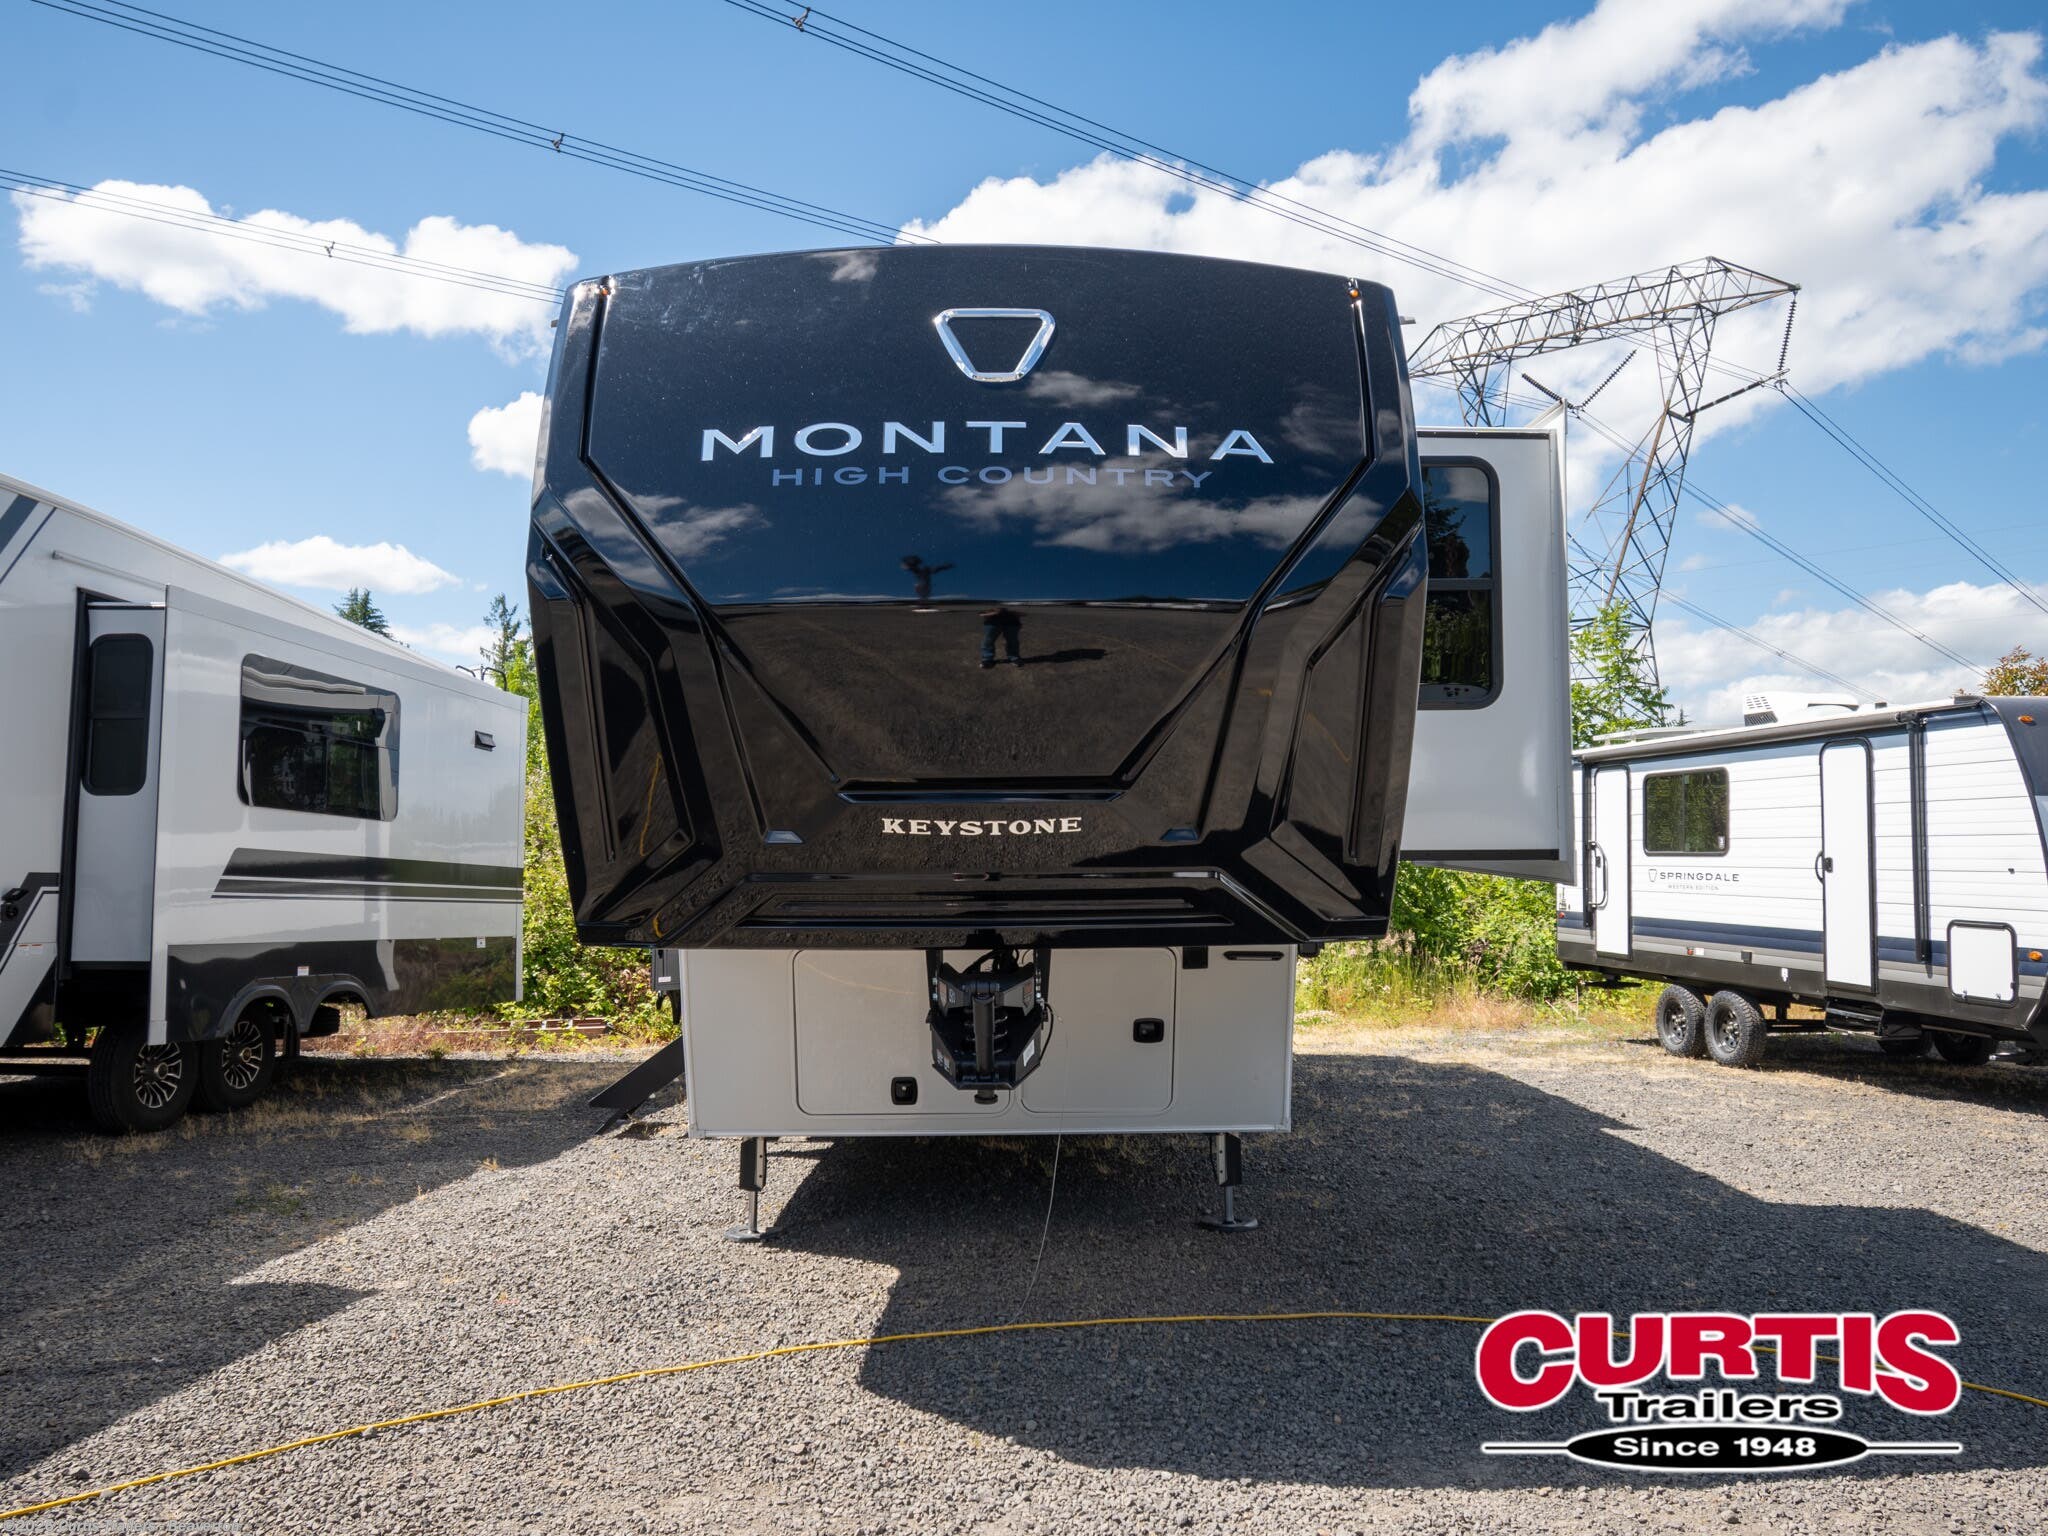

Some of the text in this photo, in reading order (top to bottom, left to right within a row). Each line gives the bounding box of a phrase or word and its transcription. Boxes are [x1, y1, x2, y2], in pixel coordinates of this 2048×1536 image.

[700, 420, 1275, 464] MONTANA
[771, 466, 1214, 489] HIGH COUNTRY
[881, 816, 1083, 836] KEYSTONE
[1659, 871, 1740, 882] SPRINGDALE
